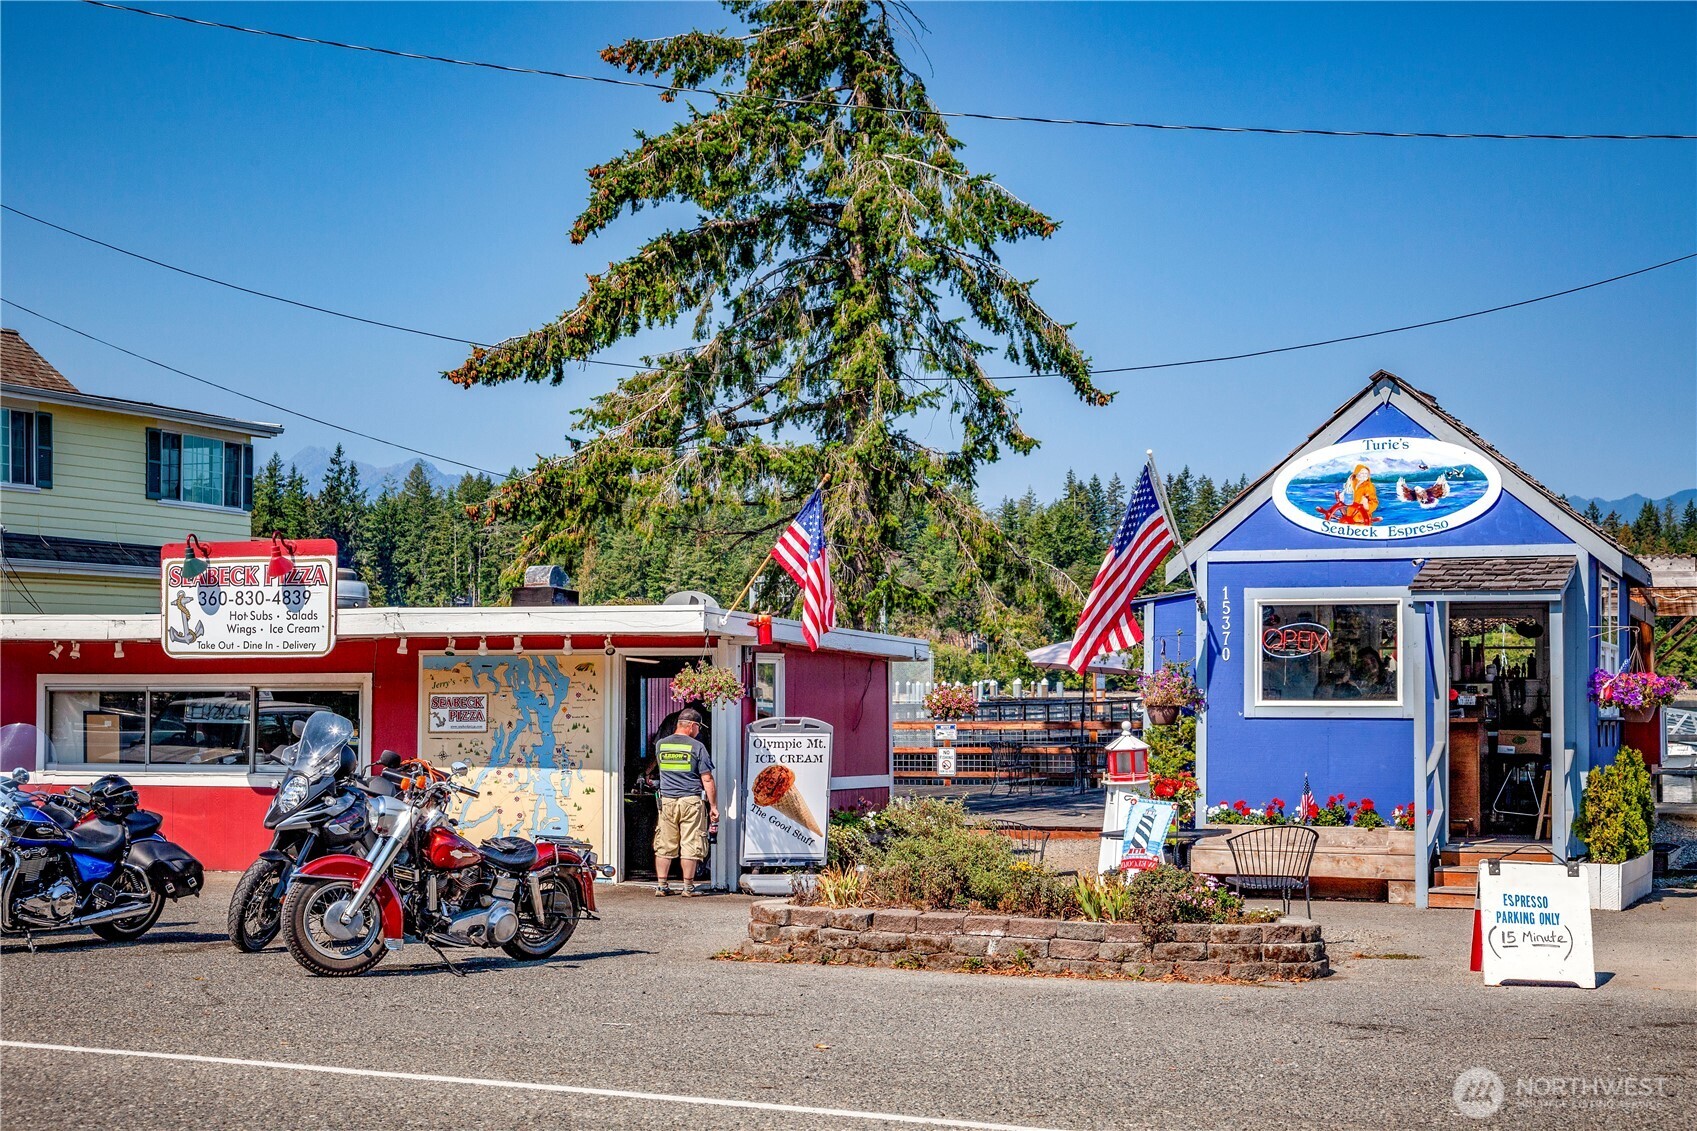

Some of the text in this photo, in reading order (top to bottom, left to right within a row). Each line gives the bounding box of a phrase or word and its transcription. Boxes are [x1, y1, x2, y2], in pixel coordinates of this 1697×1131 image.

[1362, 438, 1410, 450] Turie's
[1321, 520, 1449, 537] Seabeck Espresso
[198, 590, 312, 606] 360-830-4839
[229, 610, 318, 621] Hot Subs Salads
[227, 624, 320, 635] Wings Ice Cream
[1221, 586, 1231, 661] 15370
[197, 640, 317, 650] Take Out Dine In Delivery
[1262, 628, 1330, 653] OPEN
[431, 696, 485, 709] SEABECK
[448, 709, 486, 722] PIZZA
[753, 738, 827, 751] Olympic Mt.
[755, 754, 824, 764] ICE CREAM
[750, 803, 816, 847] The Good Stuff
[1503, 893, 1549, 908] ESPRESSO
[1496, 911, 1560, 926] PARKING ONLY
